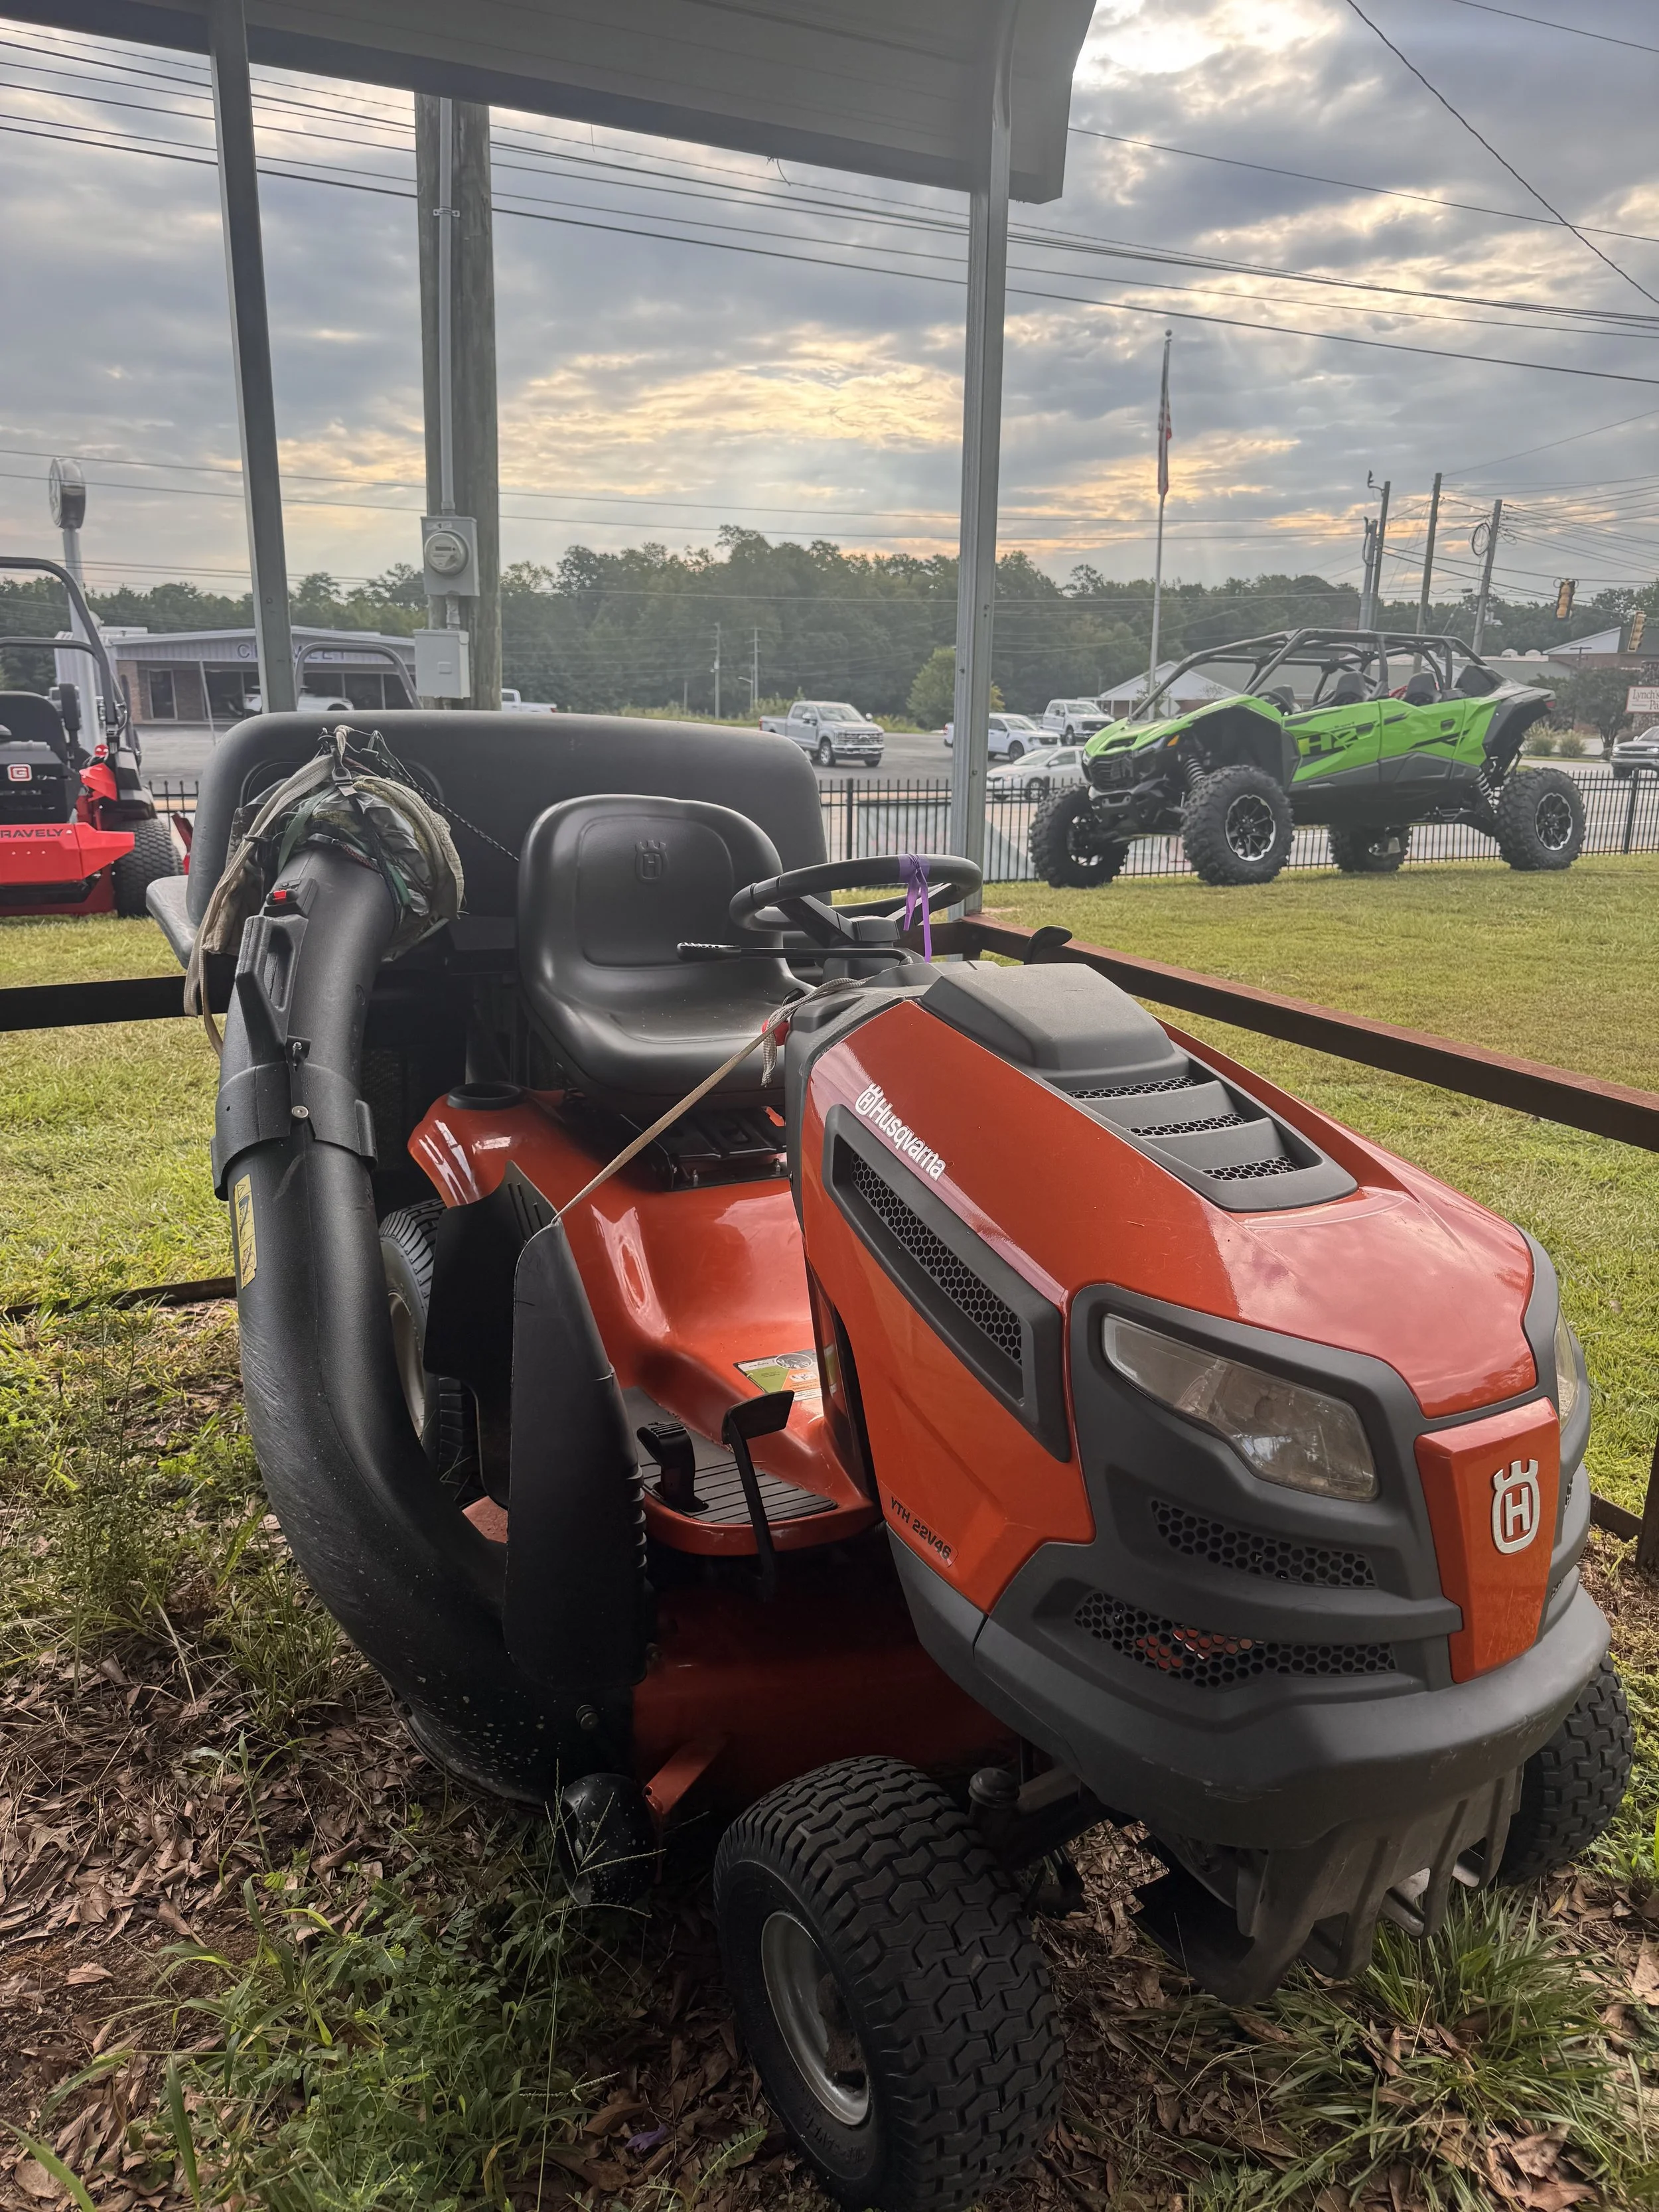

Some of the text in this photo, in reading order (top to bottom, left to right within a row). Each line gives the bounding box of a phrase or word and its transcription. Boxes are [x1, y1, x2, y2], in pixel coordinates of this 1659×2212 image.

[869, 1096, 946, 1181] Husqvarna
[891, 1496, 952, 1560] YTH 22V46
